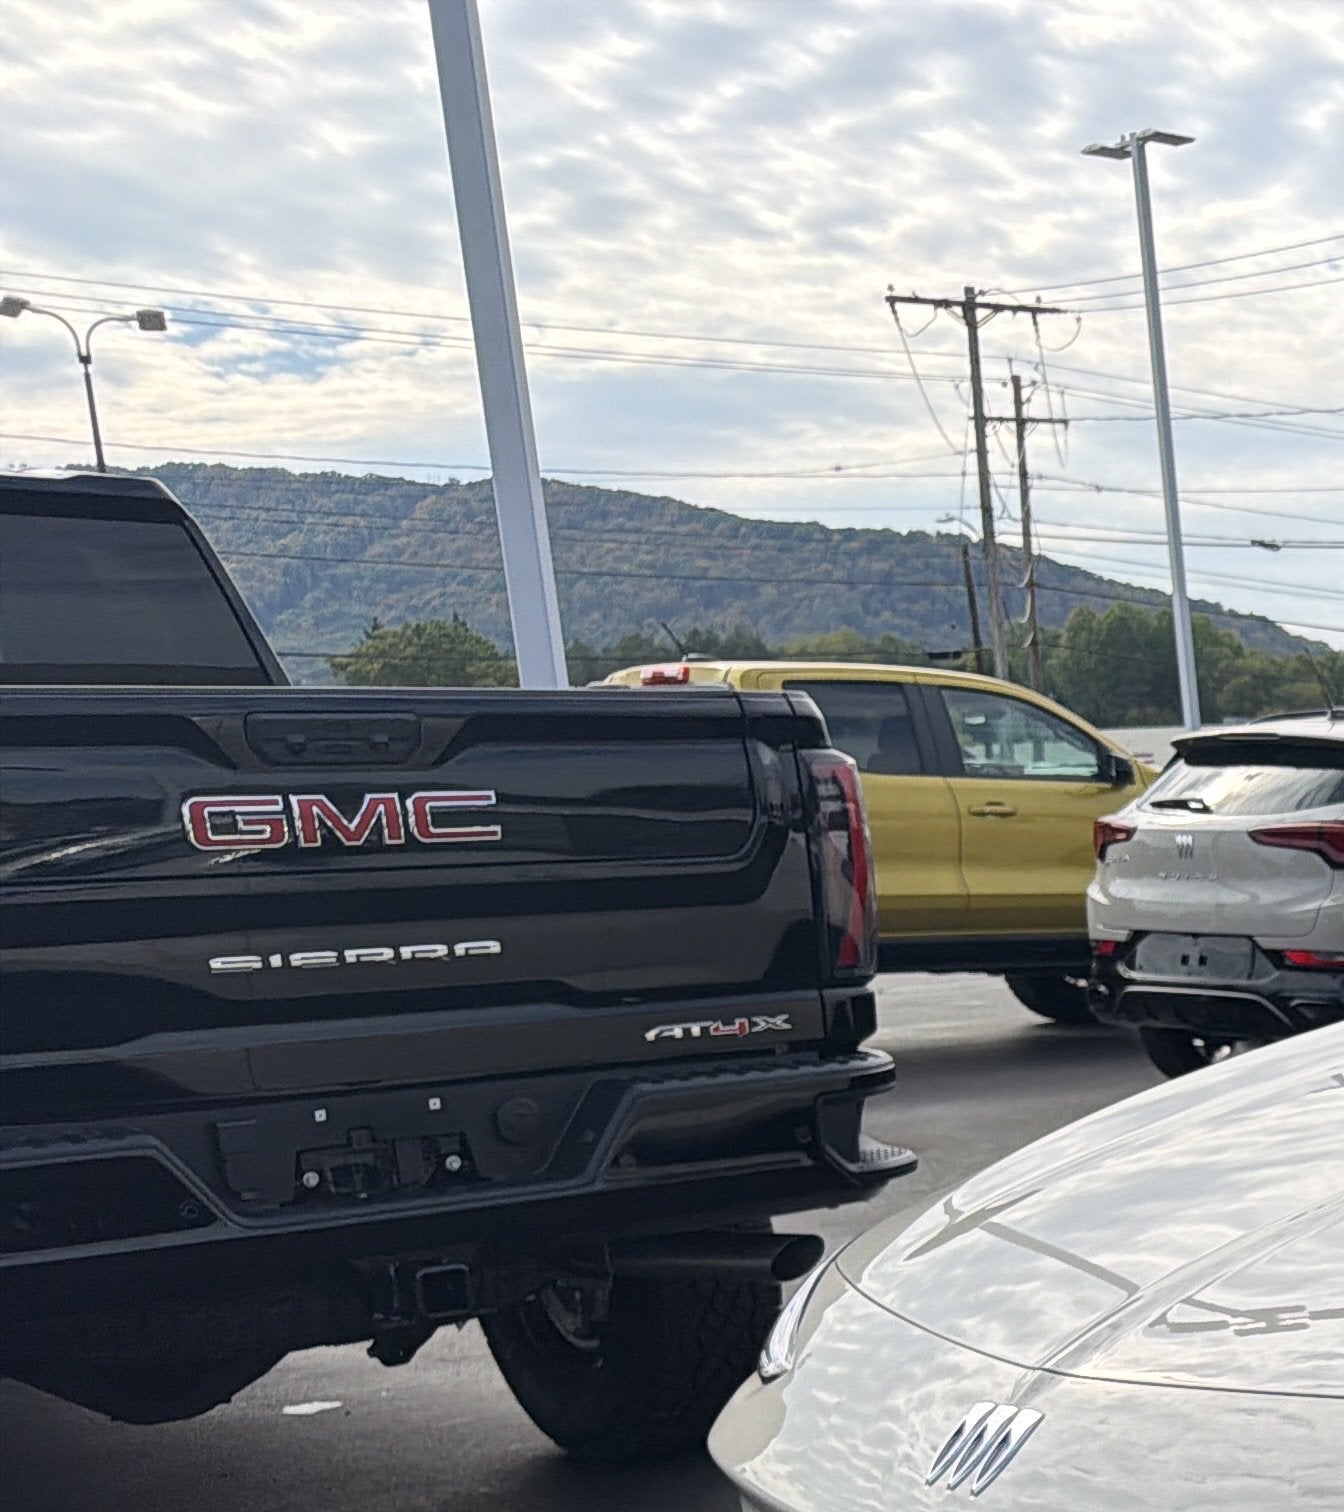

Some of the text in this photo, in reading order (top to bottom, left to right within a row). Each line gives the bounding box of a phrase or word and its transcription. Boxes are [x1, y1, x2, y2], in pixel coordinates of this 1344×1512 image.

[181, 790, 502, 852] GMC
[208, 940, 502, 972] SIERRA
[645, 1014, 793, 1042] AT4X
